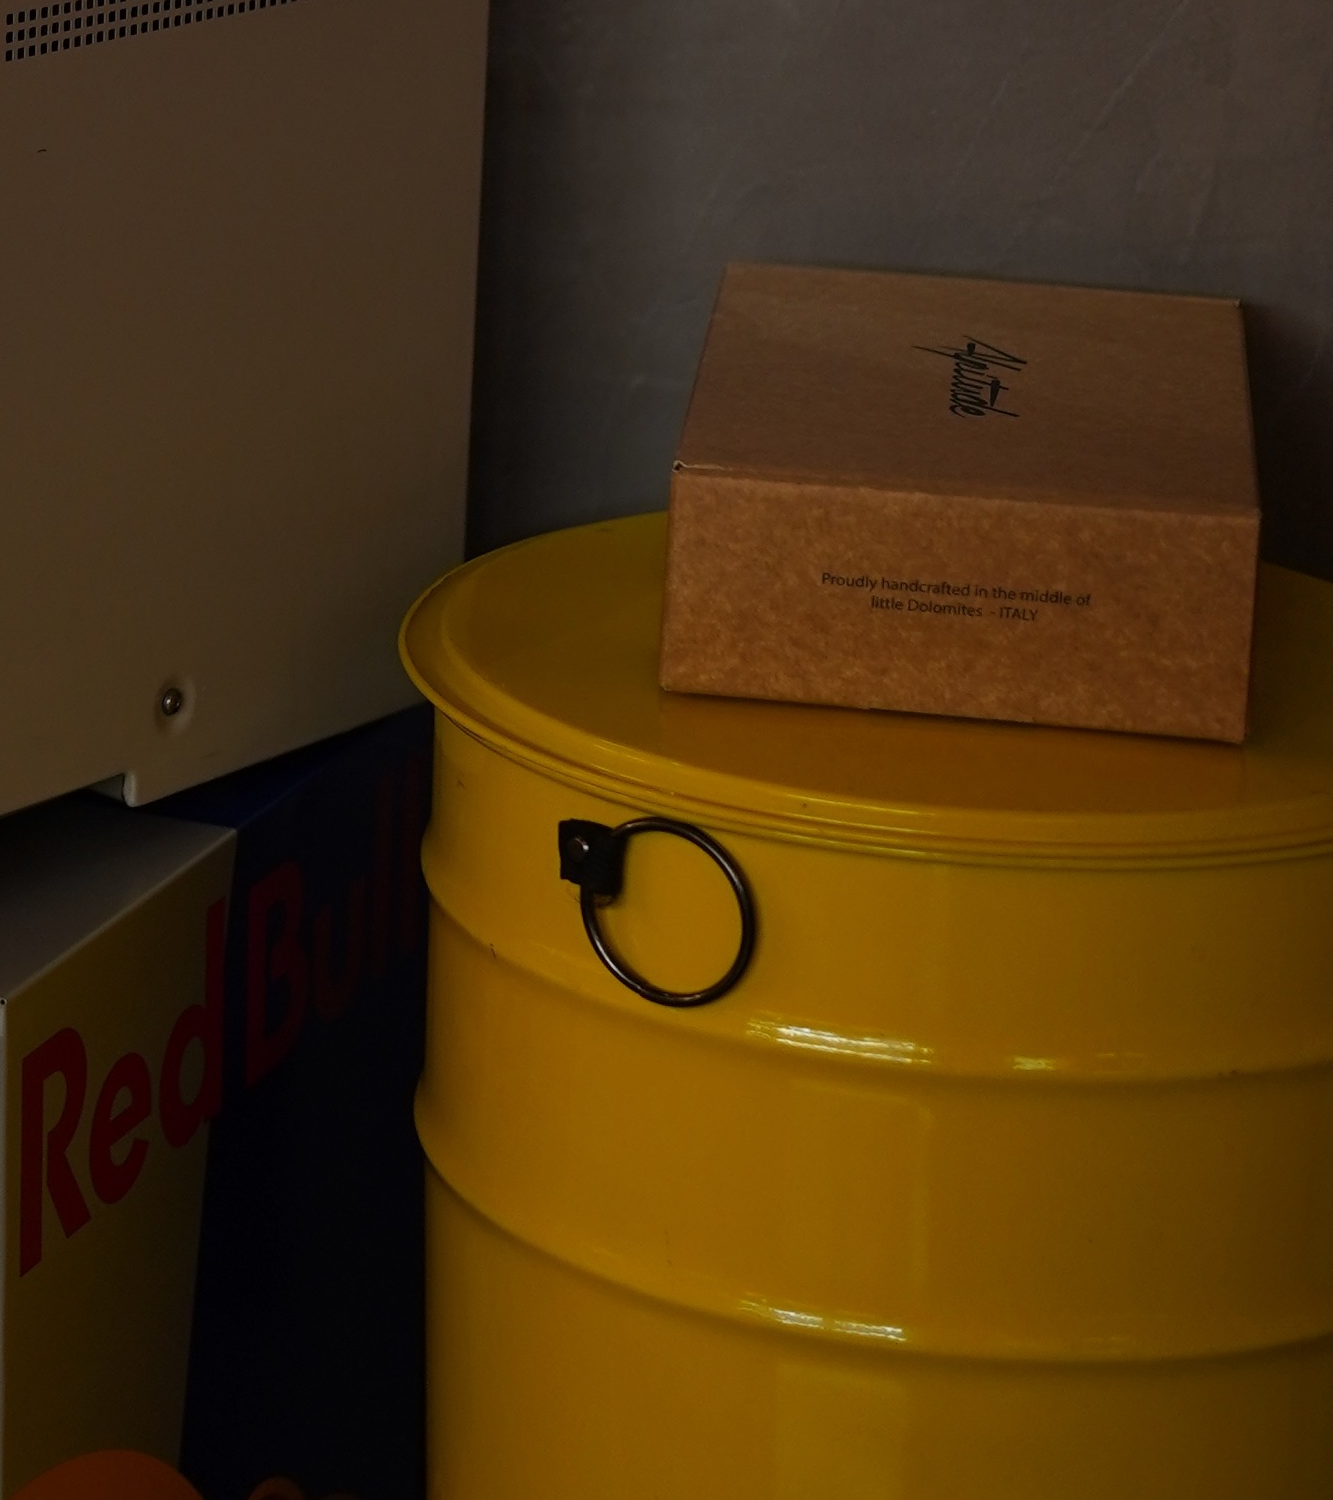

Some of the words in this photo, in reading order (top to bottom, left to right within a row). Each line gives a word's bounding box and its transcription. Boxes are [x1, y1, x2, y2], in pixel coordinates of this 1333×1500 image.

[821, 572, 878, 591] Proudly
[881, 577, 970, 597] handcrafted
[975, 584, 988, 598] in
[992, 587, 1016, 601] the
[1019, 590, 1072, 606] middle
[1076, 593, 1091, 606] of
[871, 595, 903, 611] little
[907, 599, 983, 617] Dolomites
[999, 607, 1038, 621] ITALY
[20, 897, 227, 1278] Red
[245, 752, 425, 1088] Bull
